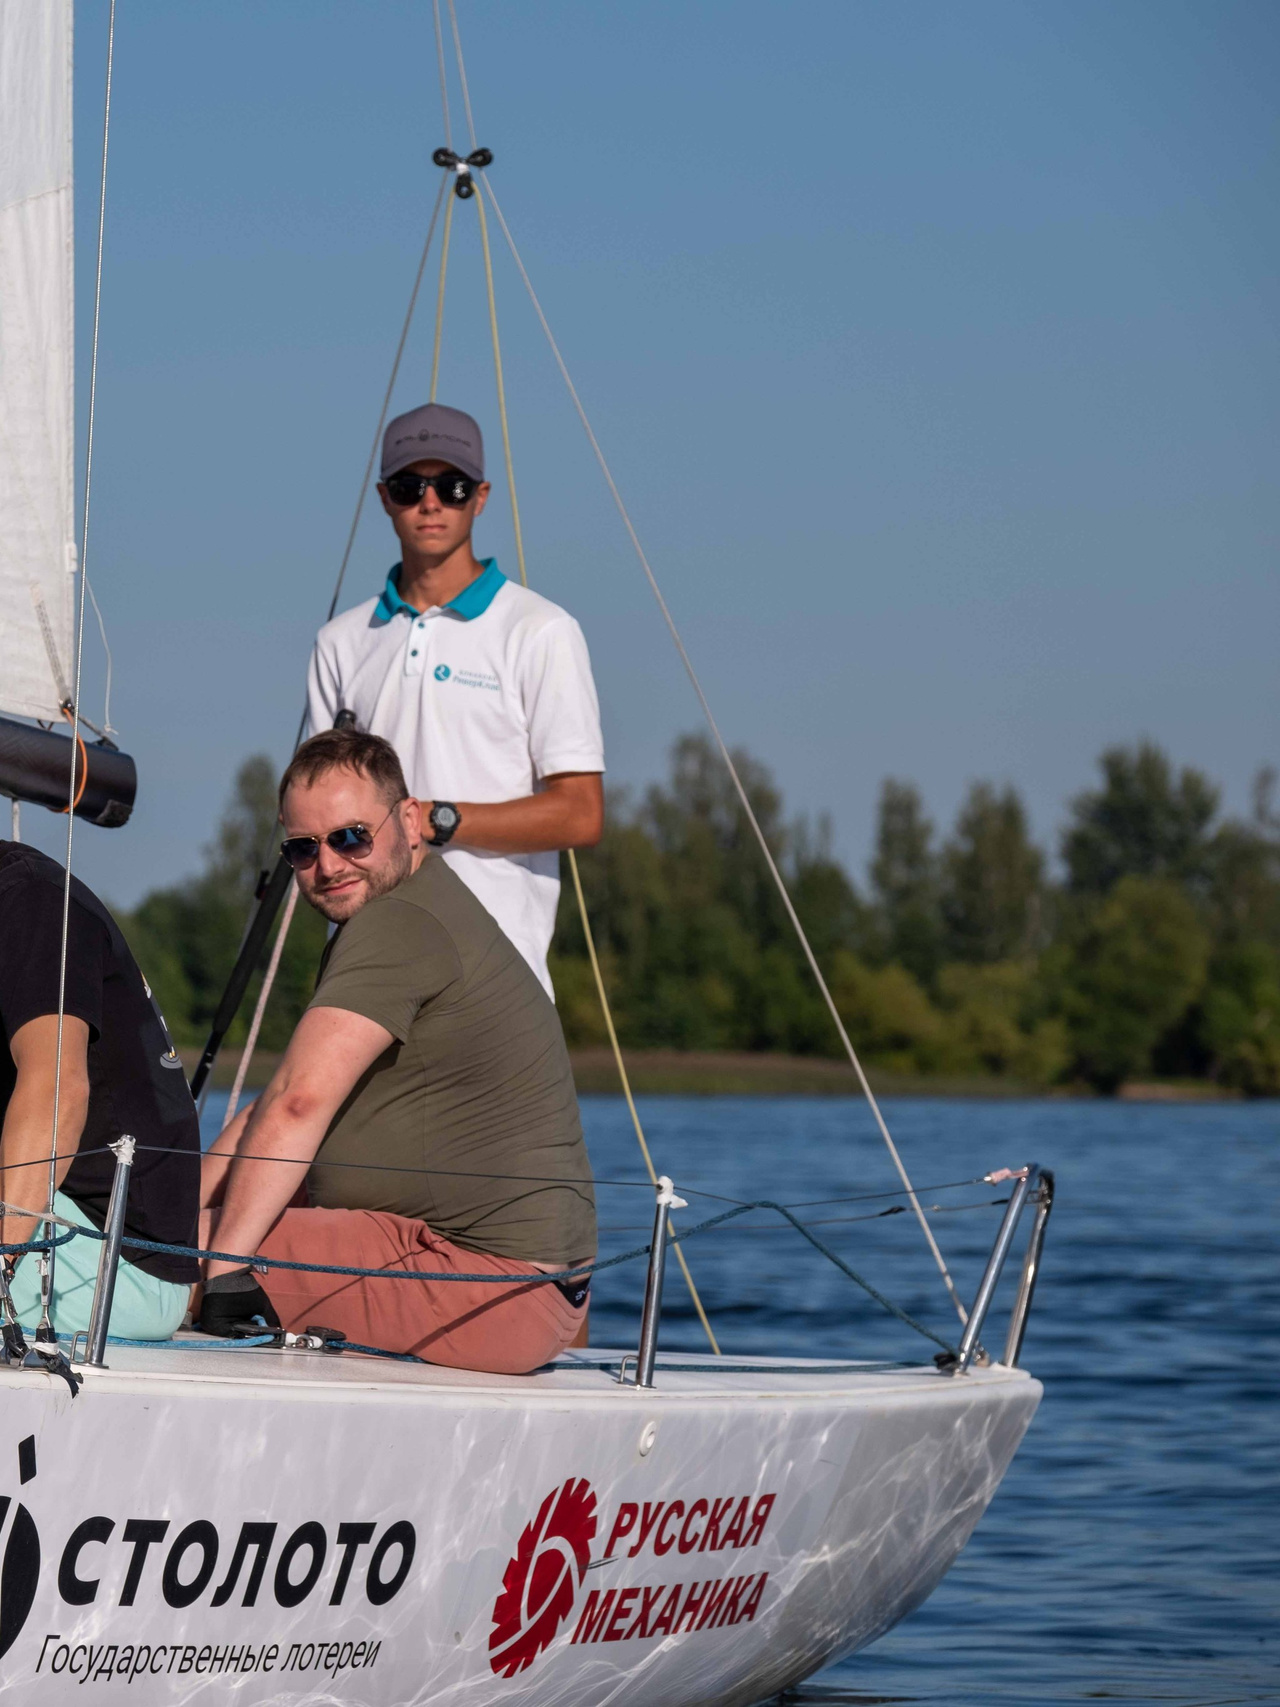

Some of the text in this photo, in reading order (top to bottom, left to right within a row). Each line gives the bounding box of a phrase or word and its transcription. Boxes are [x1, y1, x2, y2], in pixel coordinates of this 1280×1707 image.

[603, 1493, 776, 1558] РУССКАЯ
[57, 1515, 417, 1609] СТОЛОТО
[570, 1571, 769, 1644] МЕХАНИКА
[35, 1634, 383, 1685] Государственные лотереи
